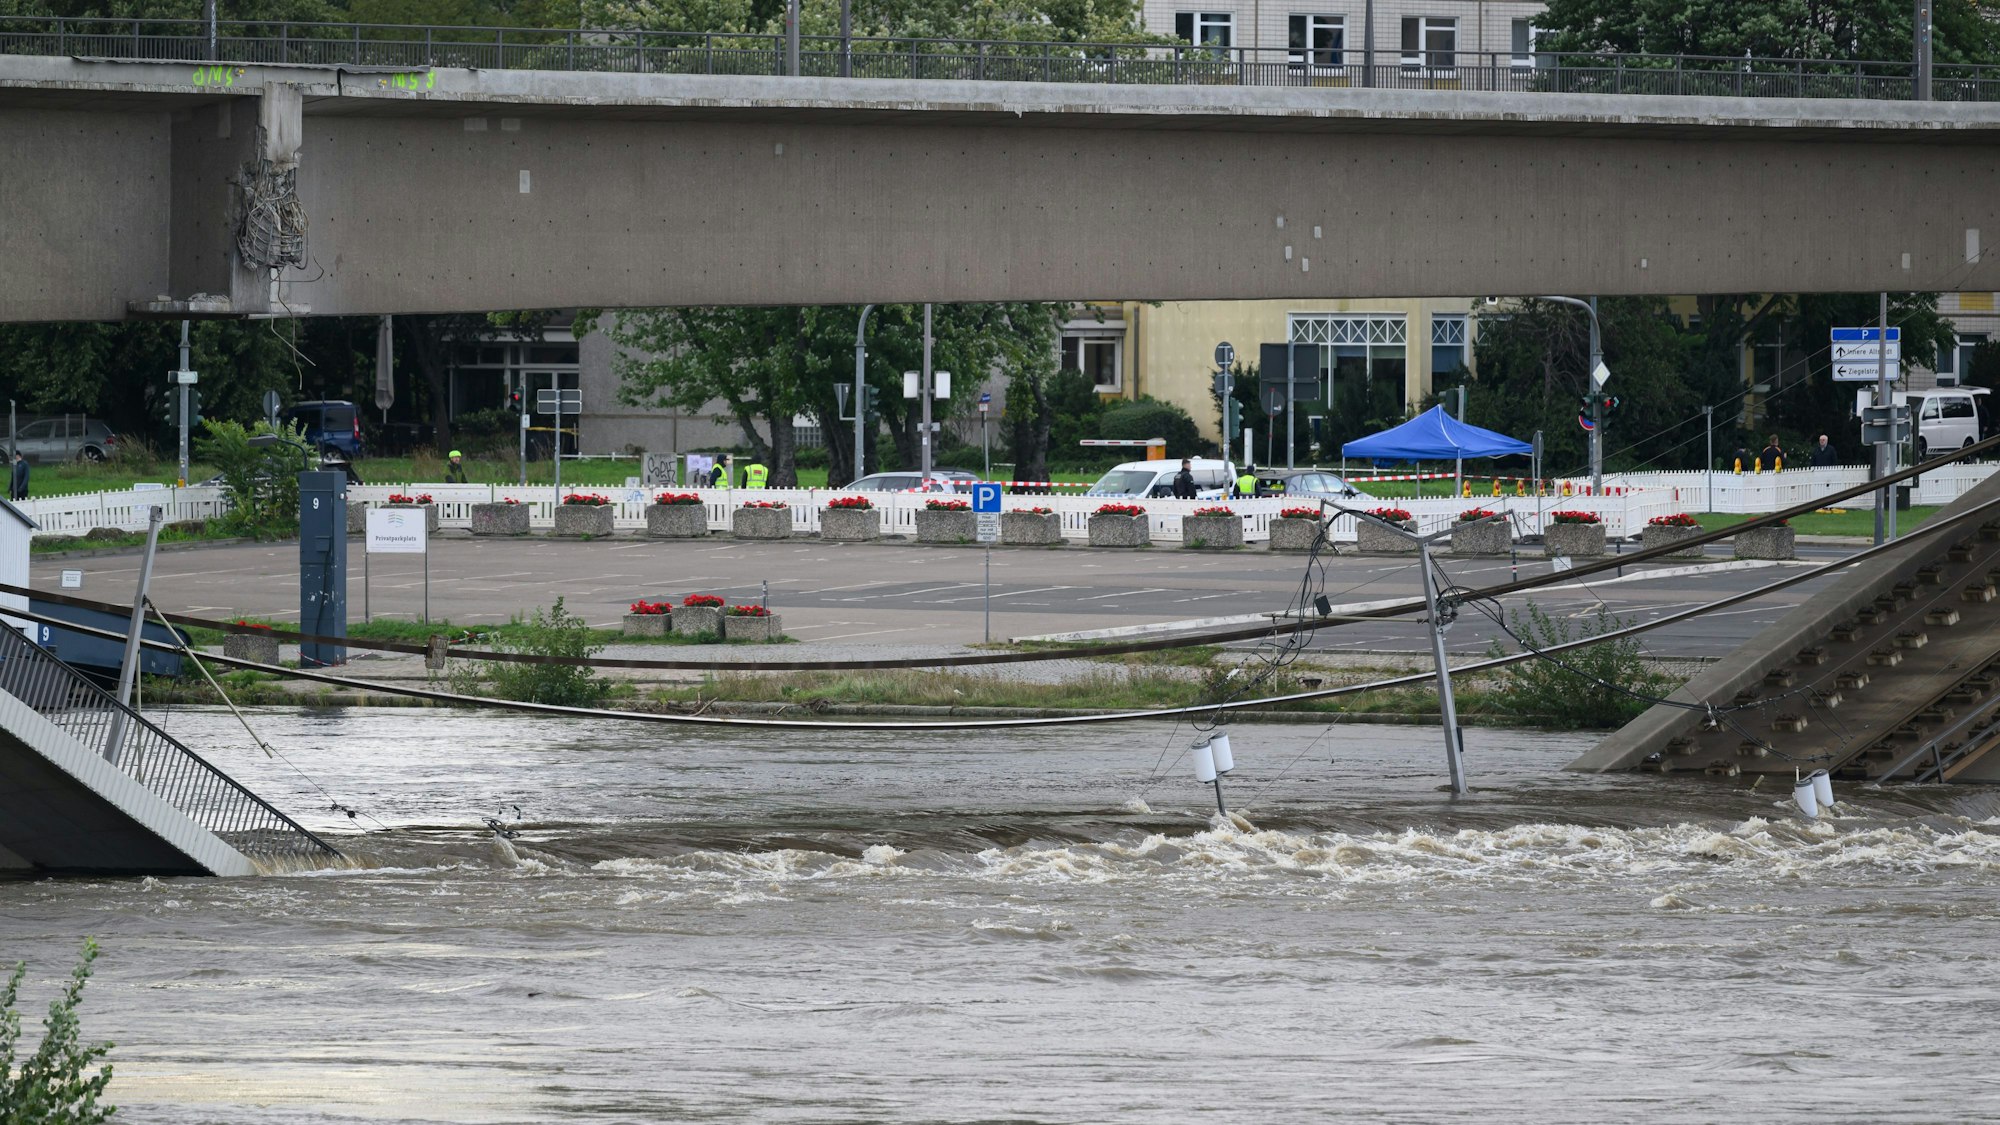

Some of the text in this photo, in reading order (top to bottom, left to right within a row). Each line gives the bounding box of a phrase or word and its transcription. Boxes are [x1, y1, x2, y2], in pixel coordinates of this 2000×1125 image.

[1862, 329, 1869, 340] P
[313, 497, 319, 510] 9
[979, 487, 995, 509] P
[43, 626, 49, 642] 9
